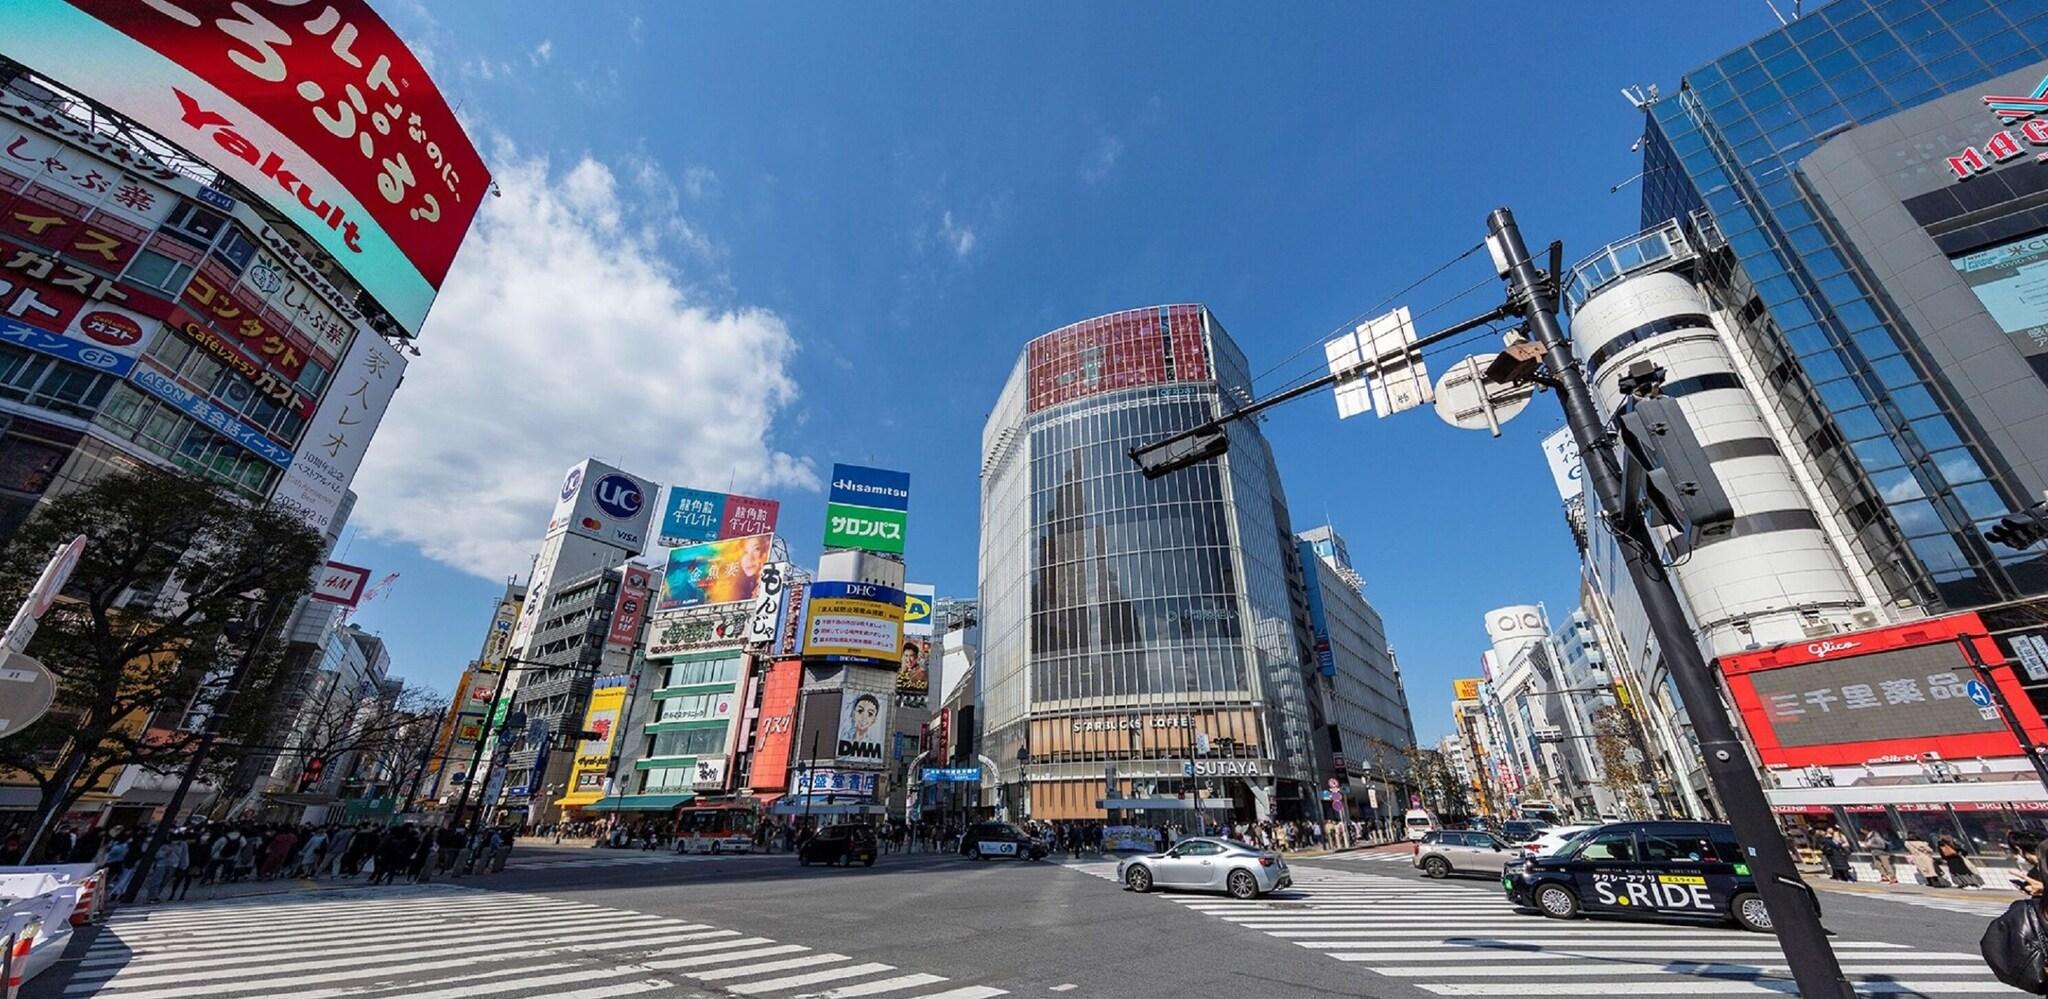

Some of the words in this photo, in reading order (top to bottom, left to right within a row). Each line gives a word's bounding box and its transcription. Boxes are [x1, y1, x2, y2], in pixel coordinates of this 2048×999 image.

[140, 0, 442, 224] ろぷる?
[6, 135, 156, 212] しゃぶ葉
[172, 87, 364, 254] Yakult
[5, 250, 129, 301] ガスト
[186, 274, 300, 368] コンタクト
[283, 285, 346, 347] しゃぶ葉
[87, 320, 135, 341] ガスト
[82, 349, 115, 366] 6F
[253, 371, 306, 412] ガスト
[141, 371, 186, 402] AEON
[191, 399, 291, 466] 英会話イーオン
[293, 462, 342, 494] ベストアルバム
[832, 479, 909, 499] Hisamitsu
[598, 479, 642, 513] UC
[679, 497, 715, 515] 龍角散
[734, 504, 768, 523] 龍角散
[616, 529, 639, 544] VISA
[831, 515, 901, 540] サロンパス
[322, 573, 353, 591] H&M
[846, 583, 877, 597] DHC
[752, 562, 783, 640] もんじゃ
[1807, 639, 1862, 657] Glico
[1770, 672, 1967, 718] 三千里薬品
[1072, 718, 1142, 733] STARBUCKS
[1149, 716, 1196, 729] COFFEE
[838, 740, 882, 758] DMM
[1592, 873, 1657, 884] タクシーアプリ
[1594, 880, 1717, 910] S.RIDE
